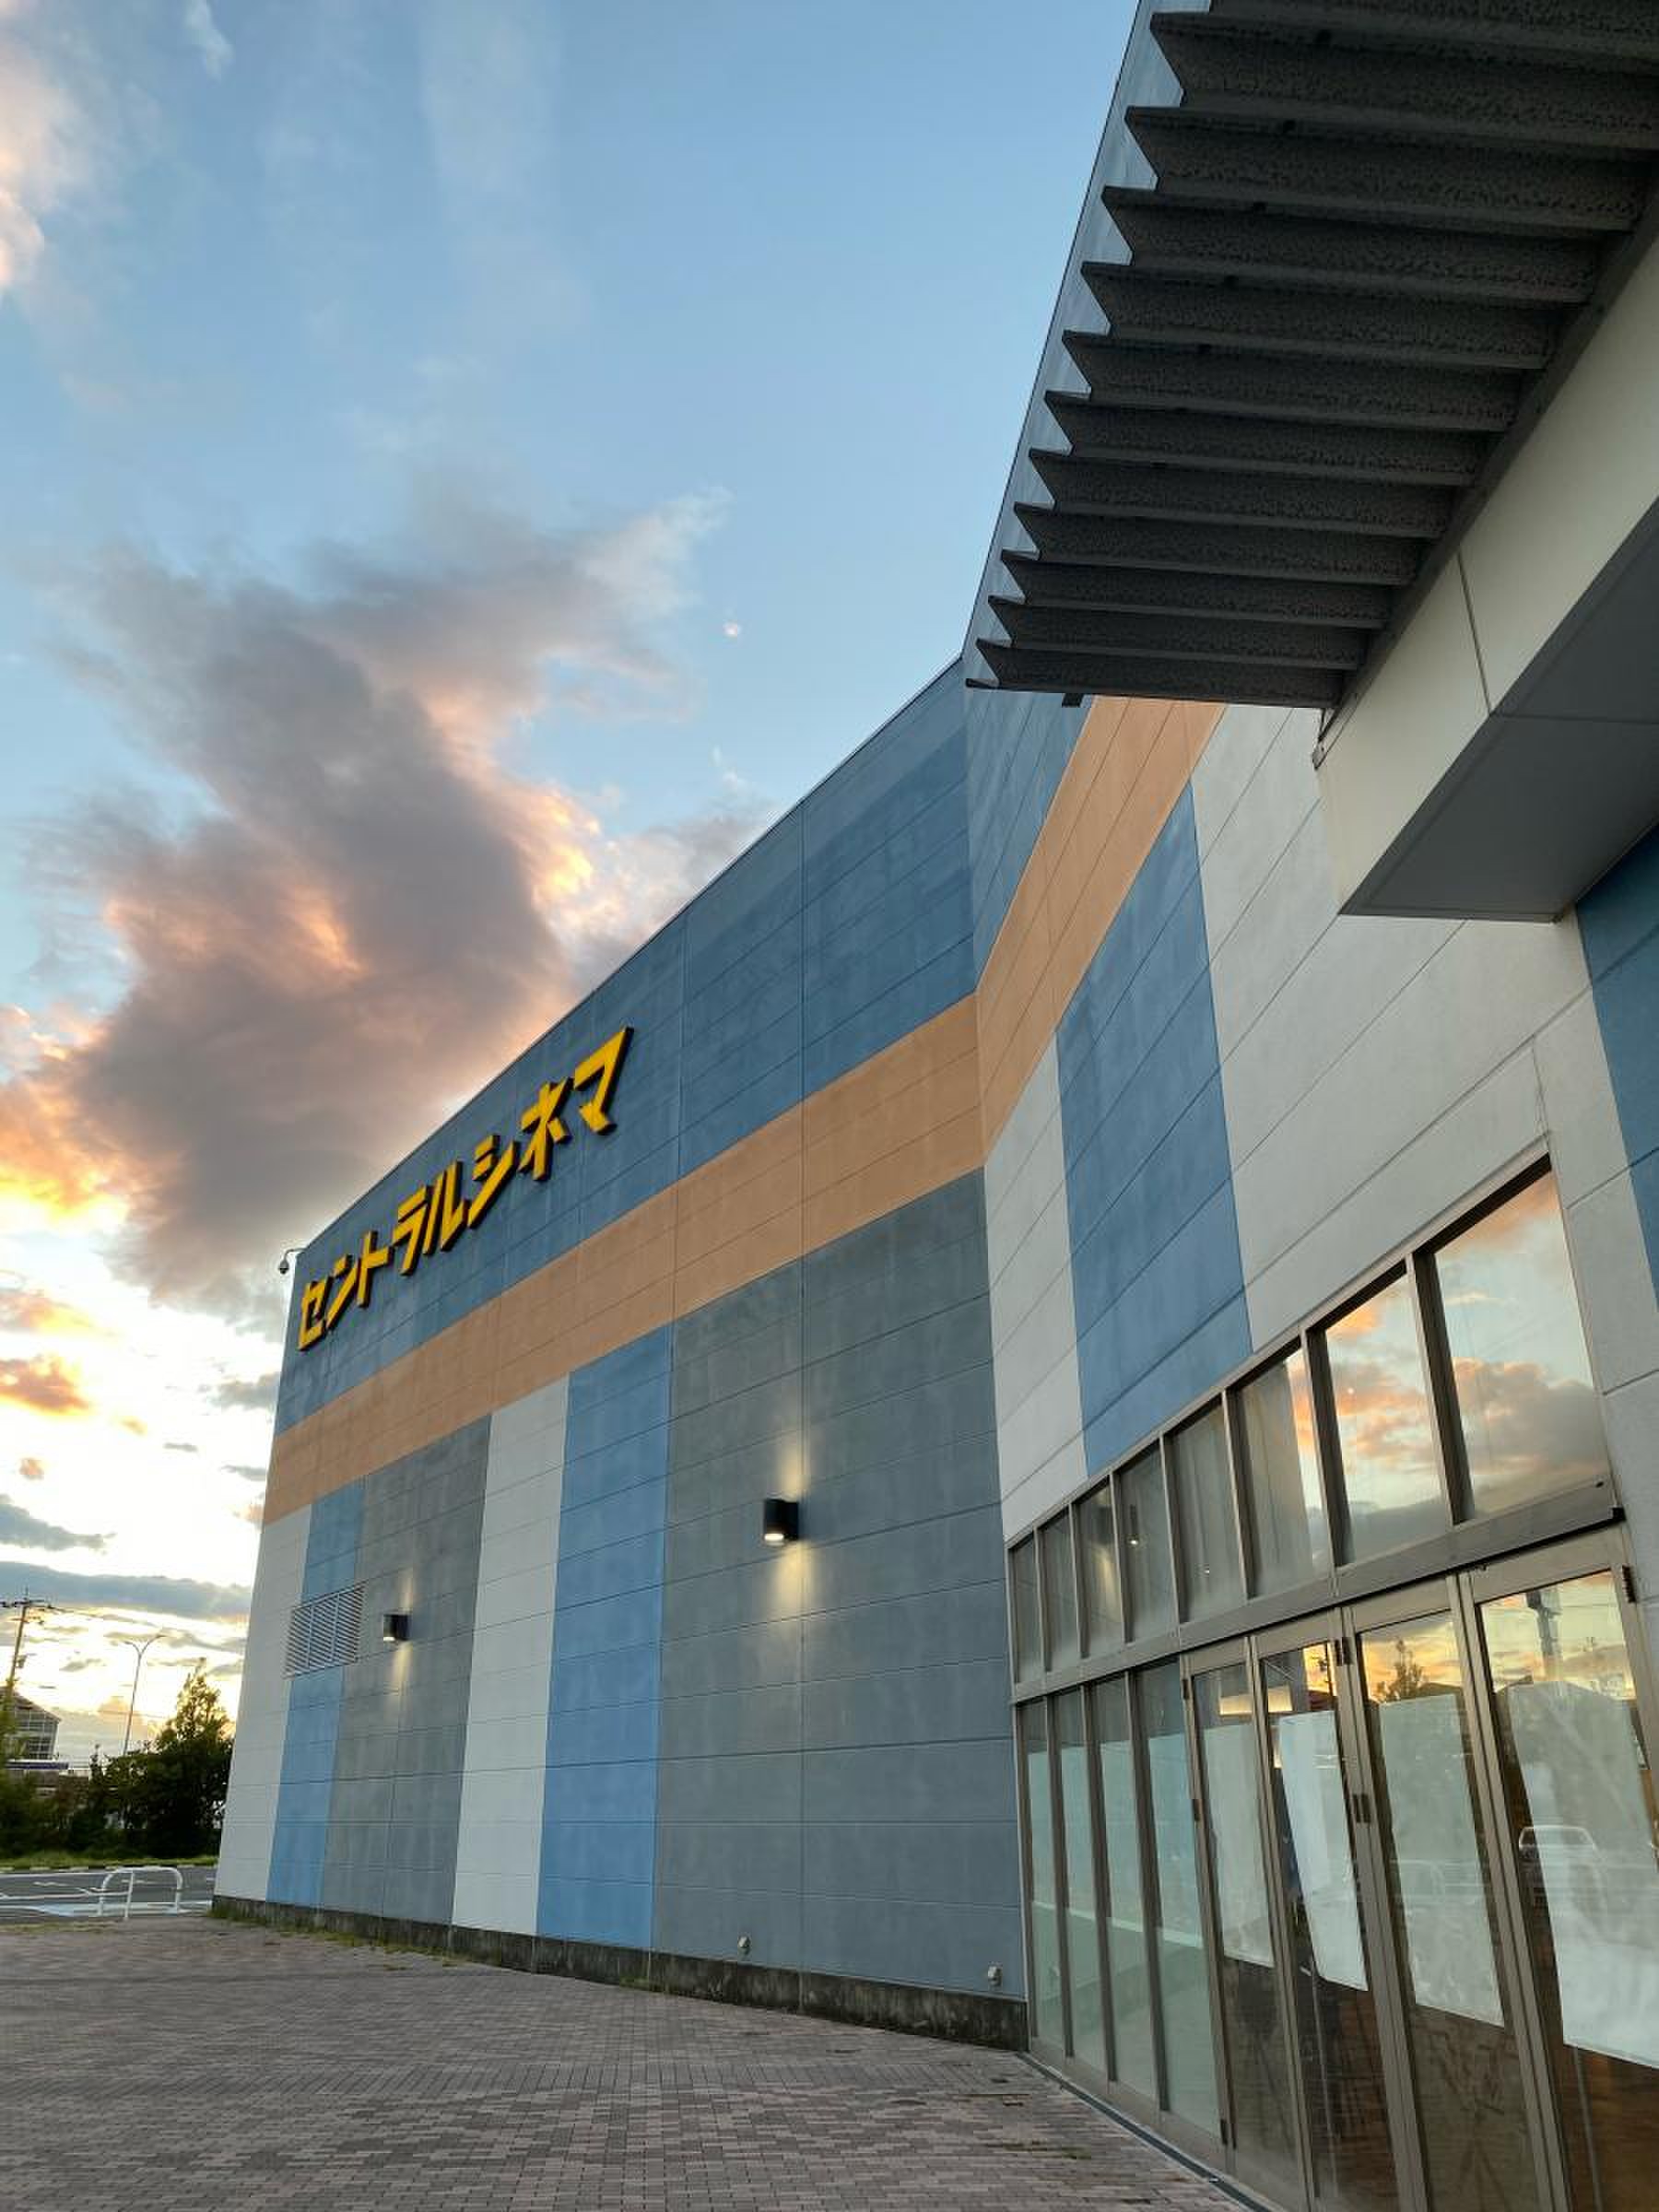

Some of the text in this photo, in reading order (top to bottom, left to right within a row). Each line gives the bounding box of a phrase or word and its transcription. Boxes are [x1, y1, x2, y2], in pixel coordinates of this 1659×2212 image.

[299, 1027, 633, 1350] セントラルシネマ
